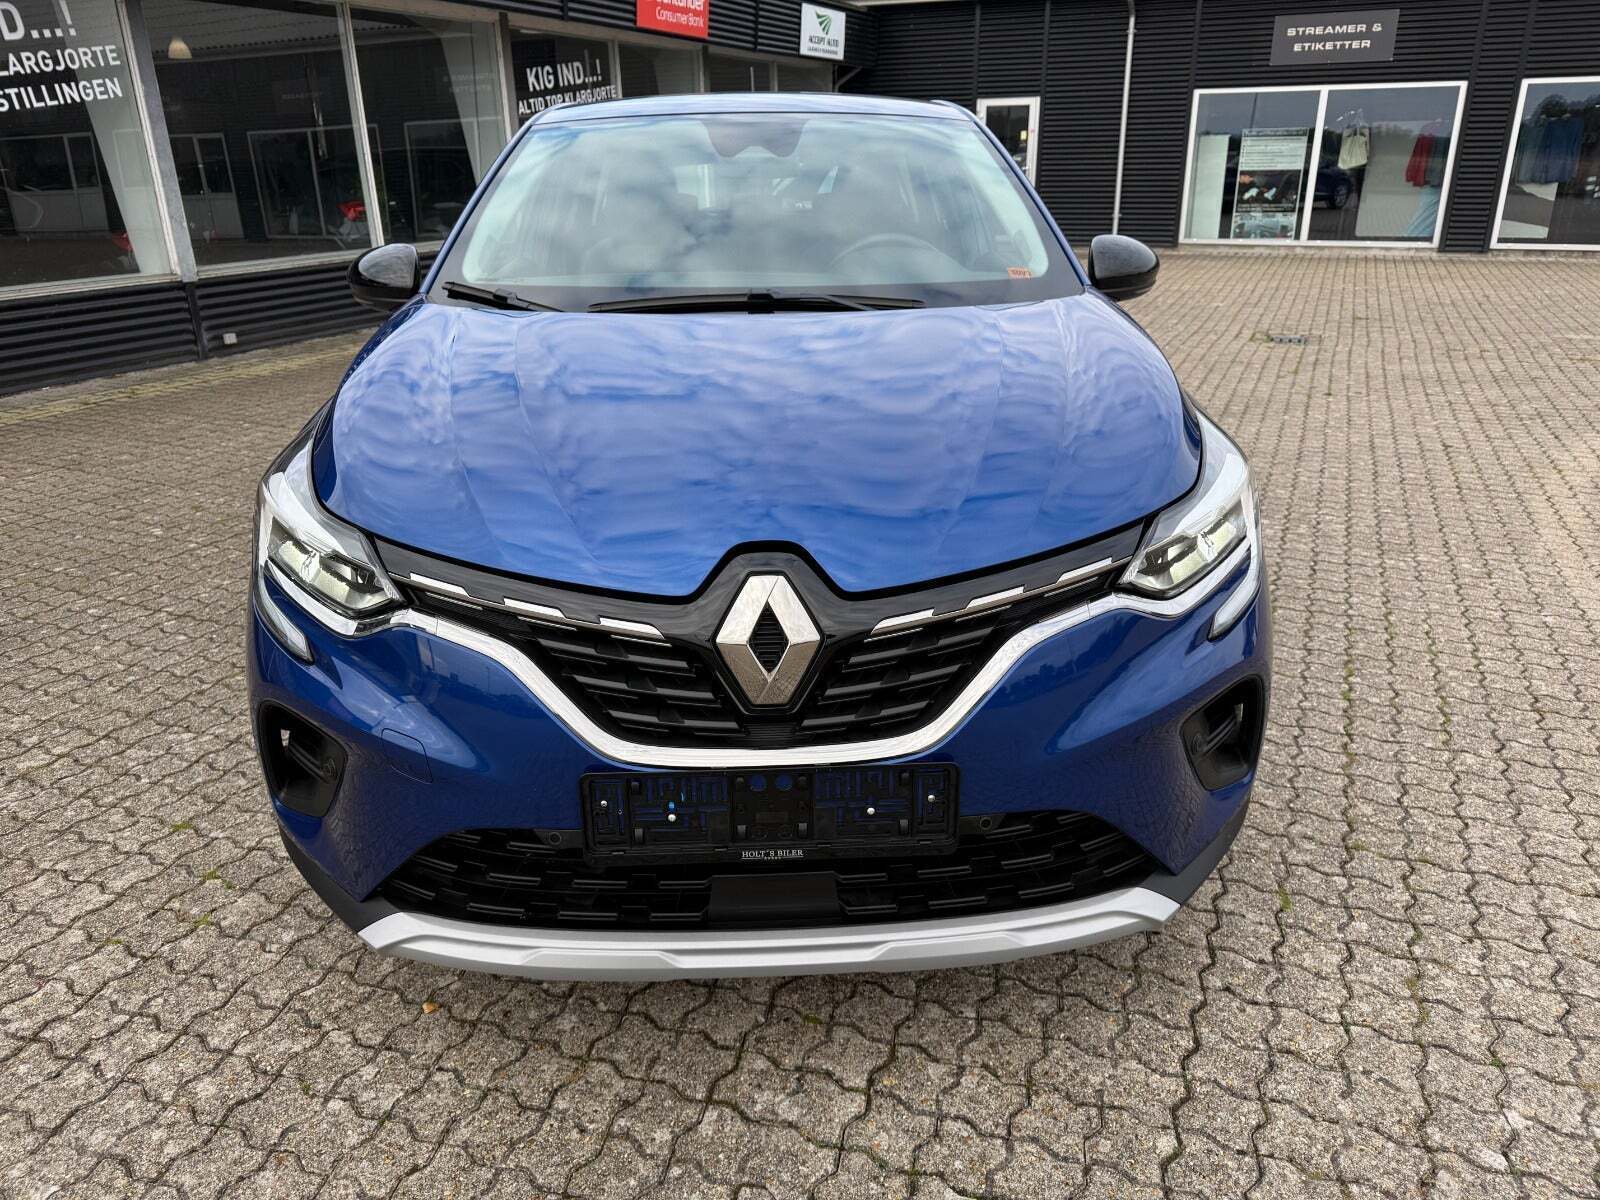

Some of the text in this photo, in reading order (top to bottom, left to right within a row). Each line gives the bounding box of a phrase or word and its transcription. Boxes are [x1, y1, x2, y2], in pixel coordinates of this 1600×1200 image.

[1287, 23, 1383, 36] STREAMER &
[1293, 40, 1371, 52] ETIKETTER
[526, 58, 603, 92] KIG IND...!
[518, 85, 617, 115] ALTID TOP KLARGJORTE
[777, 849, 804, 857] BILER
